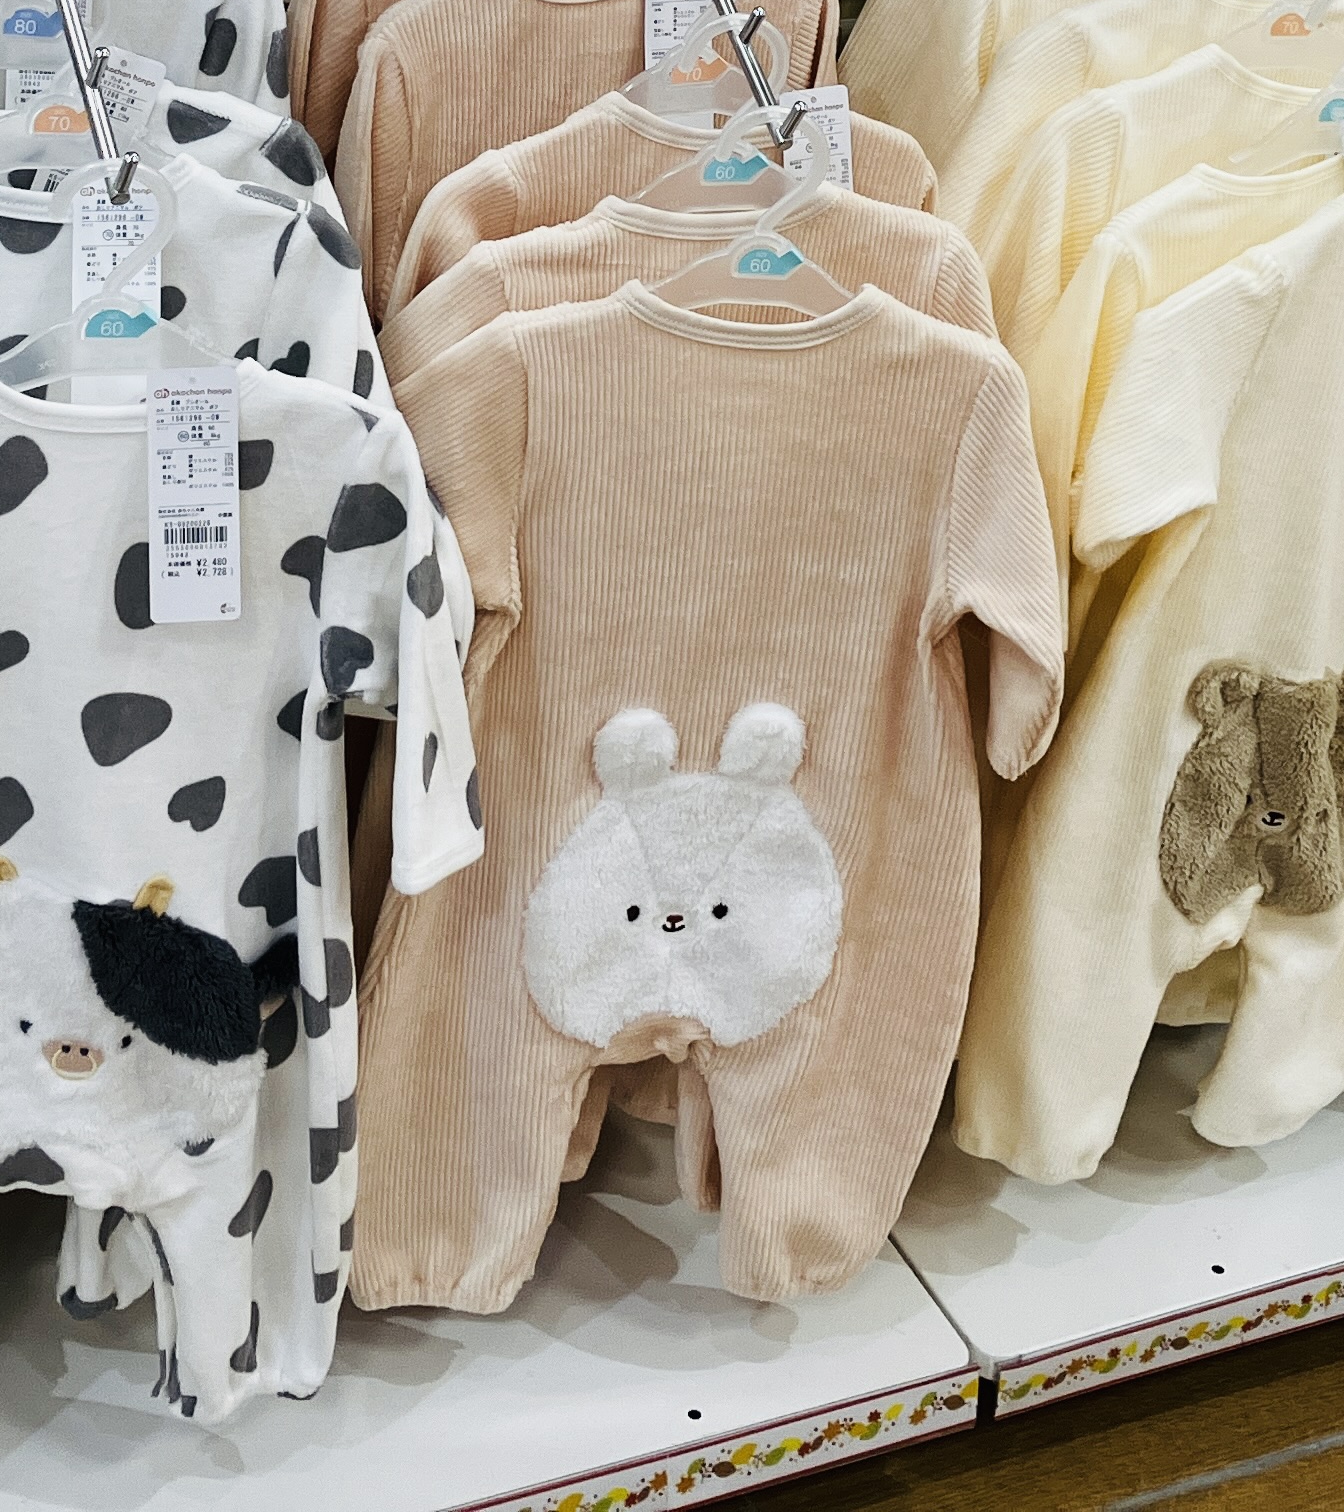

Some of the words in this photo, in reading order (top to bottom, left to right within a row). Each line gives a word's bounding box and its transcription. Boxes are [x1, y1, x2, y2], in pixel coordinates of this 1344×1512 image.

[14, 20, 37, 35] 80
[48, 116, 71, 131] 70
[715, 167, 735, 180] 60
[750, 259, 771, 273] 60
[100, 321, 124, 337] 60
